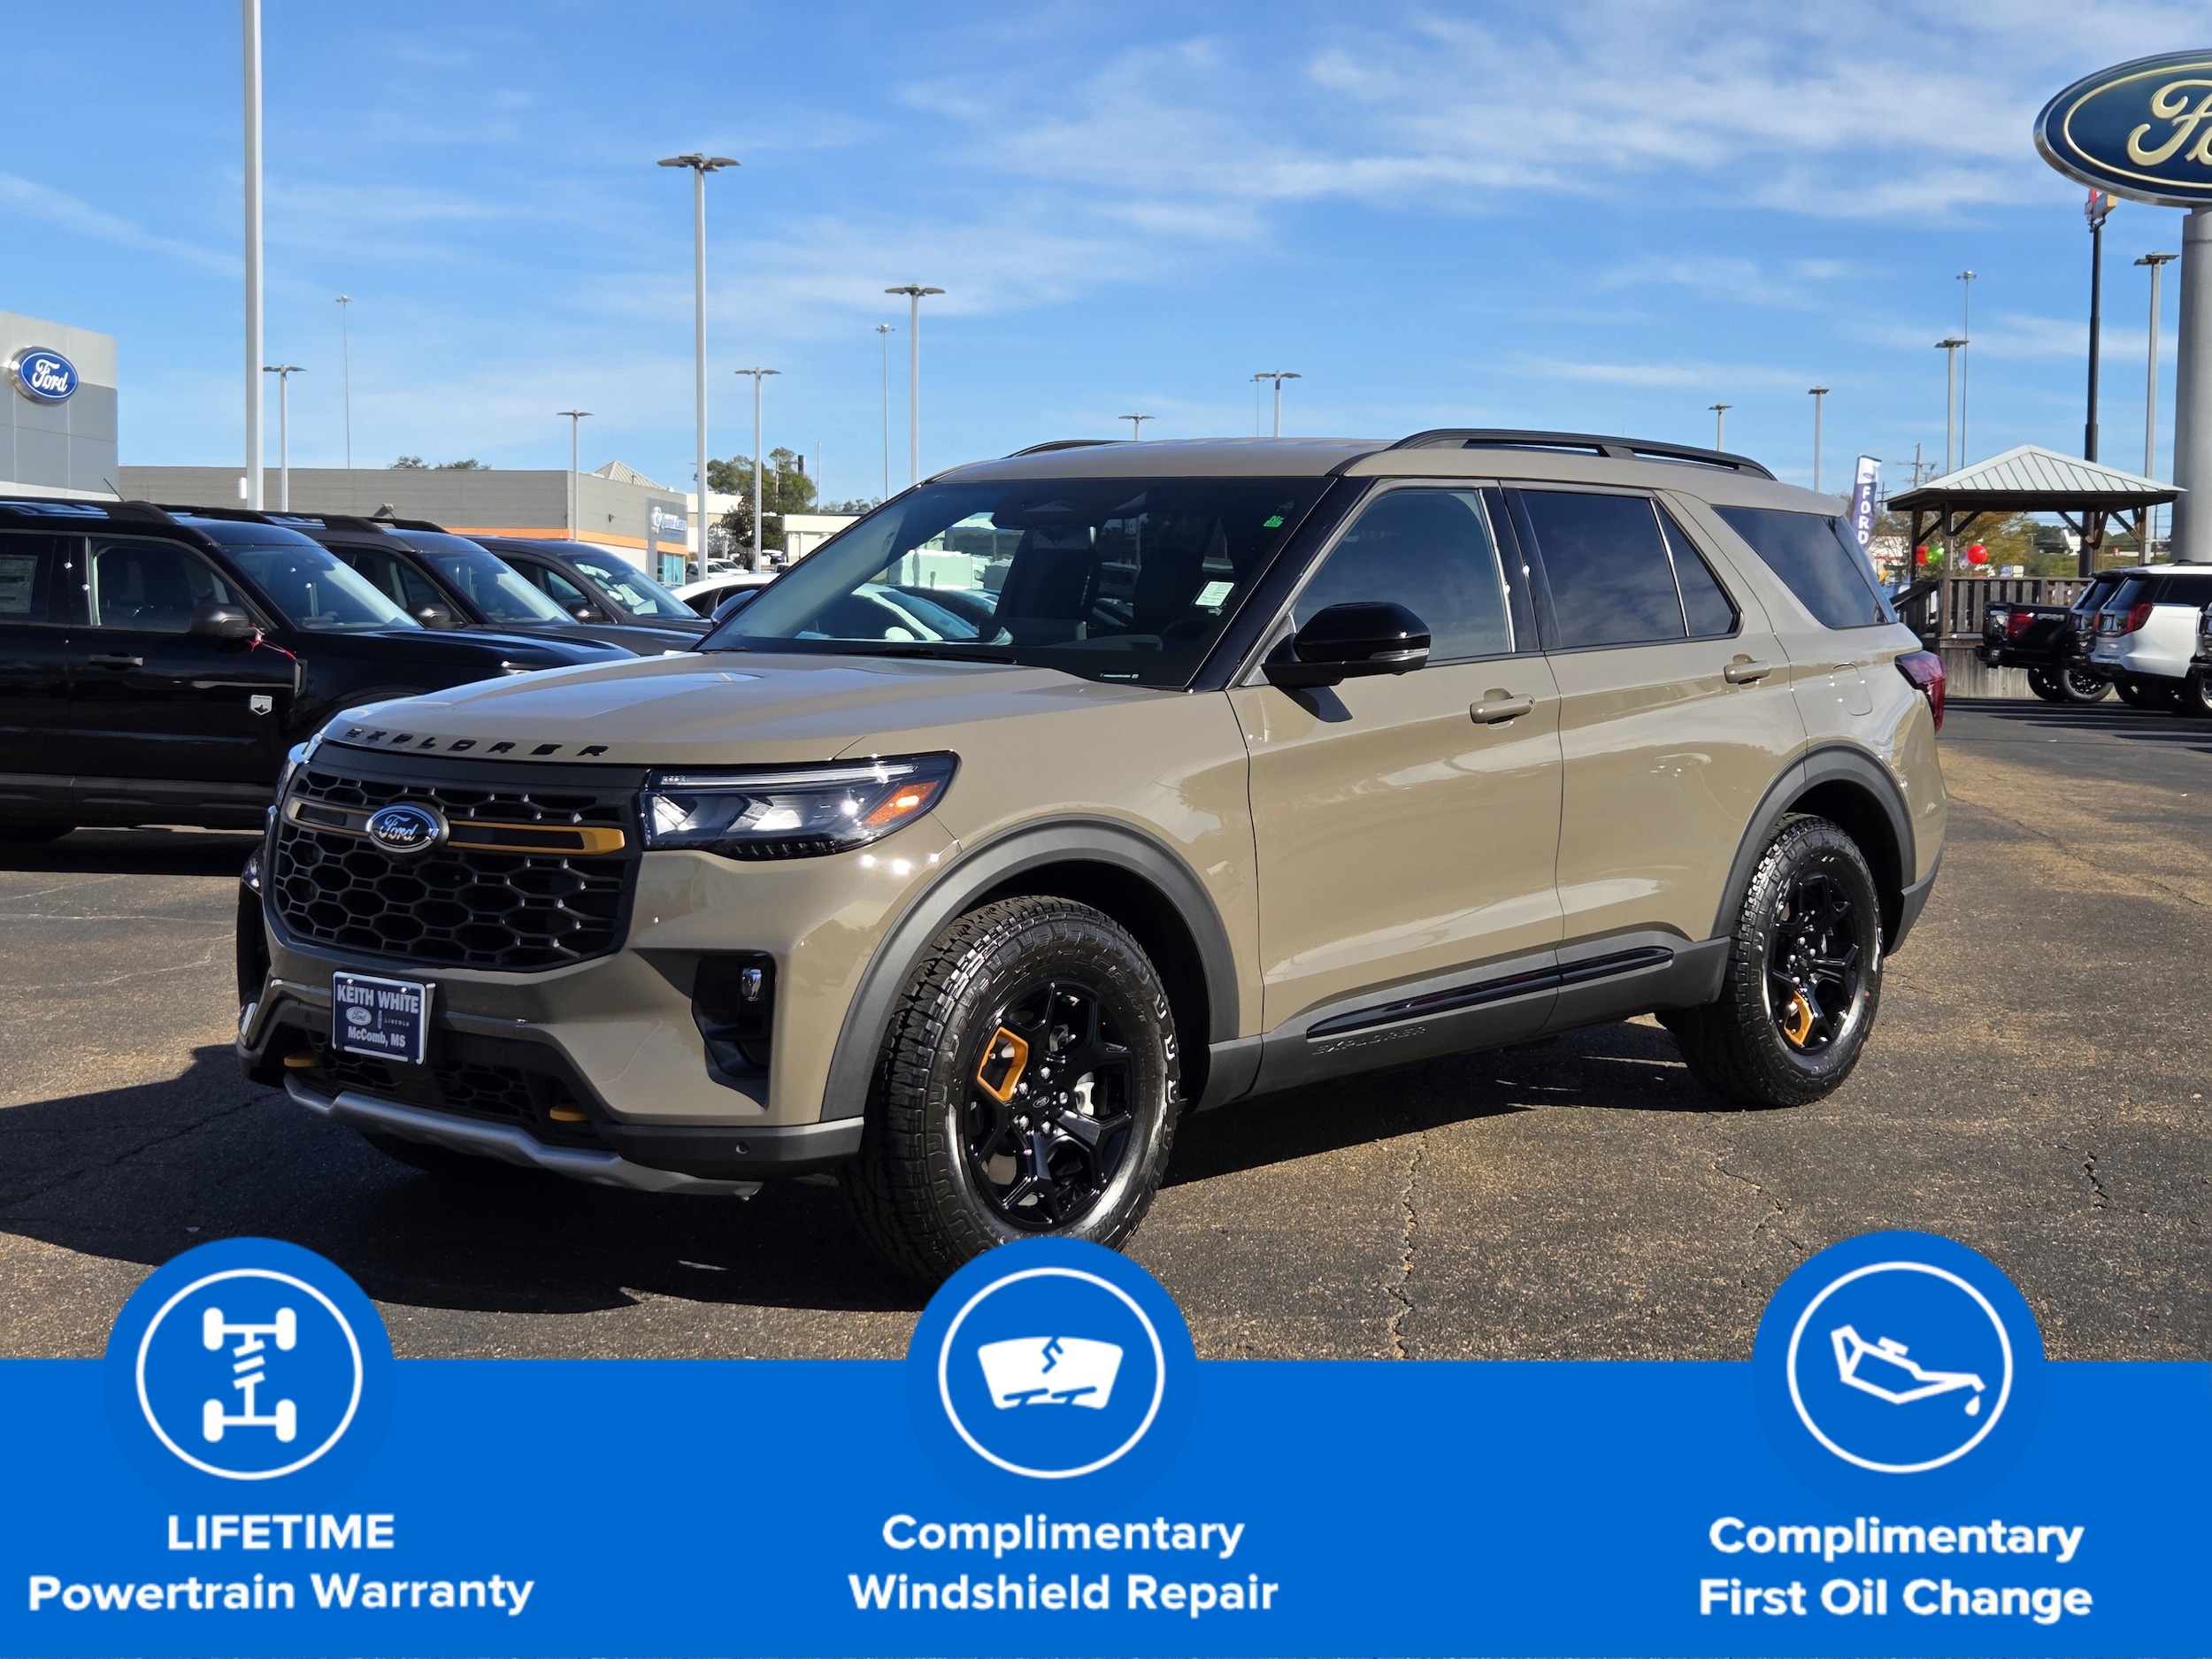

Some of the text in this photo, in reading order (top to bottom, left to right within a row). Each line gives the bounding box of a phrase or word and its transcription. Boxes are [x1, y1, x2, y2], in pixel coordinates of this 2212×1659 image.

[32, 358, 68, 392] Ford
[1858, 485, 1871, 545] FORD
[346, 727, 610, 757] EXPLORER
[379, 813, 419, 841] Ford
[337, 984, 419, 1014] KEITH WHITE
[351, 1010, 367, 1022] Ford
[348, 1025, 406, 1048] McComb, MS
